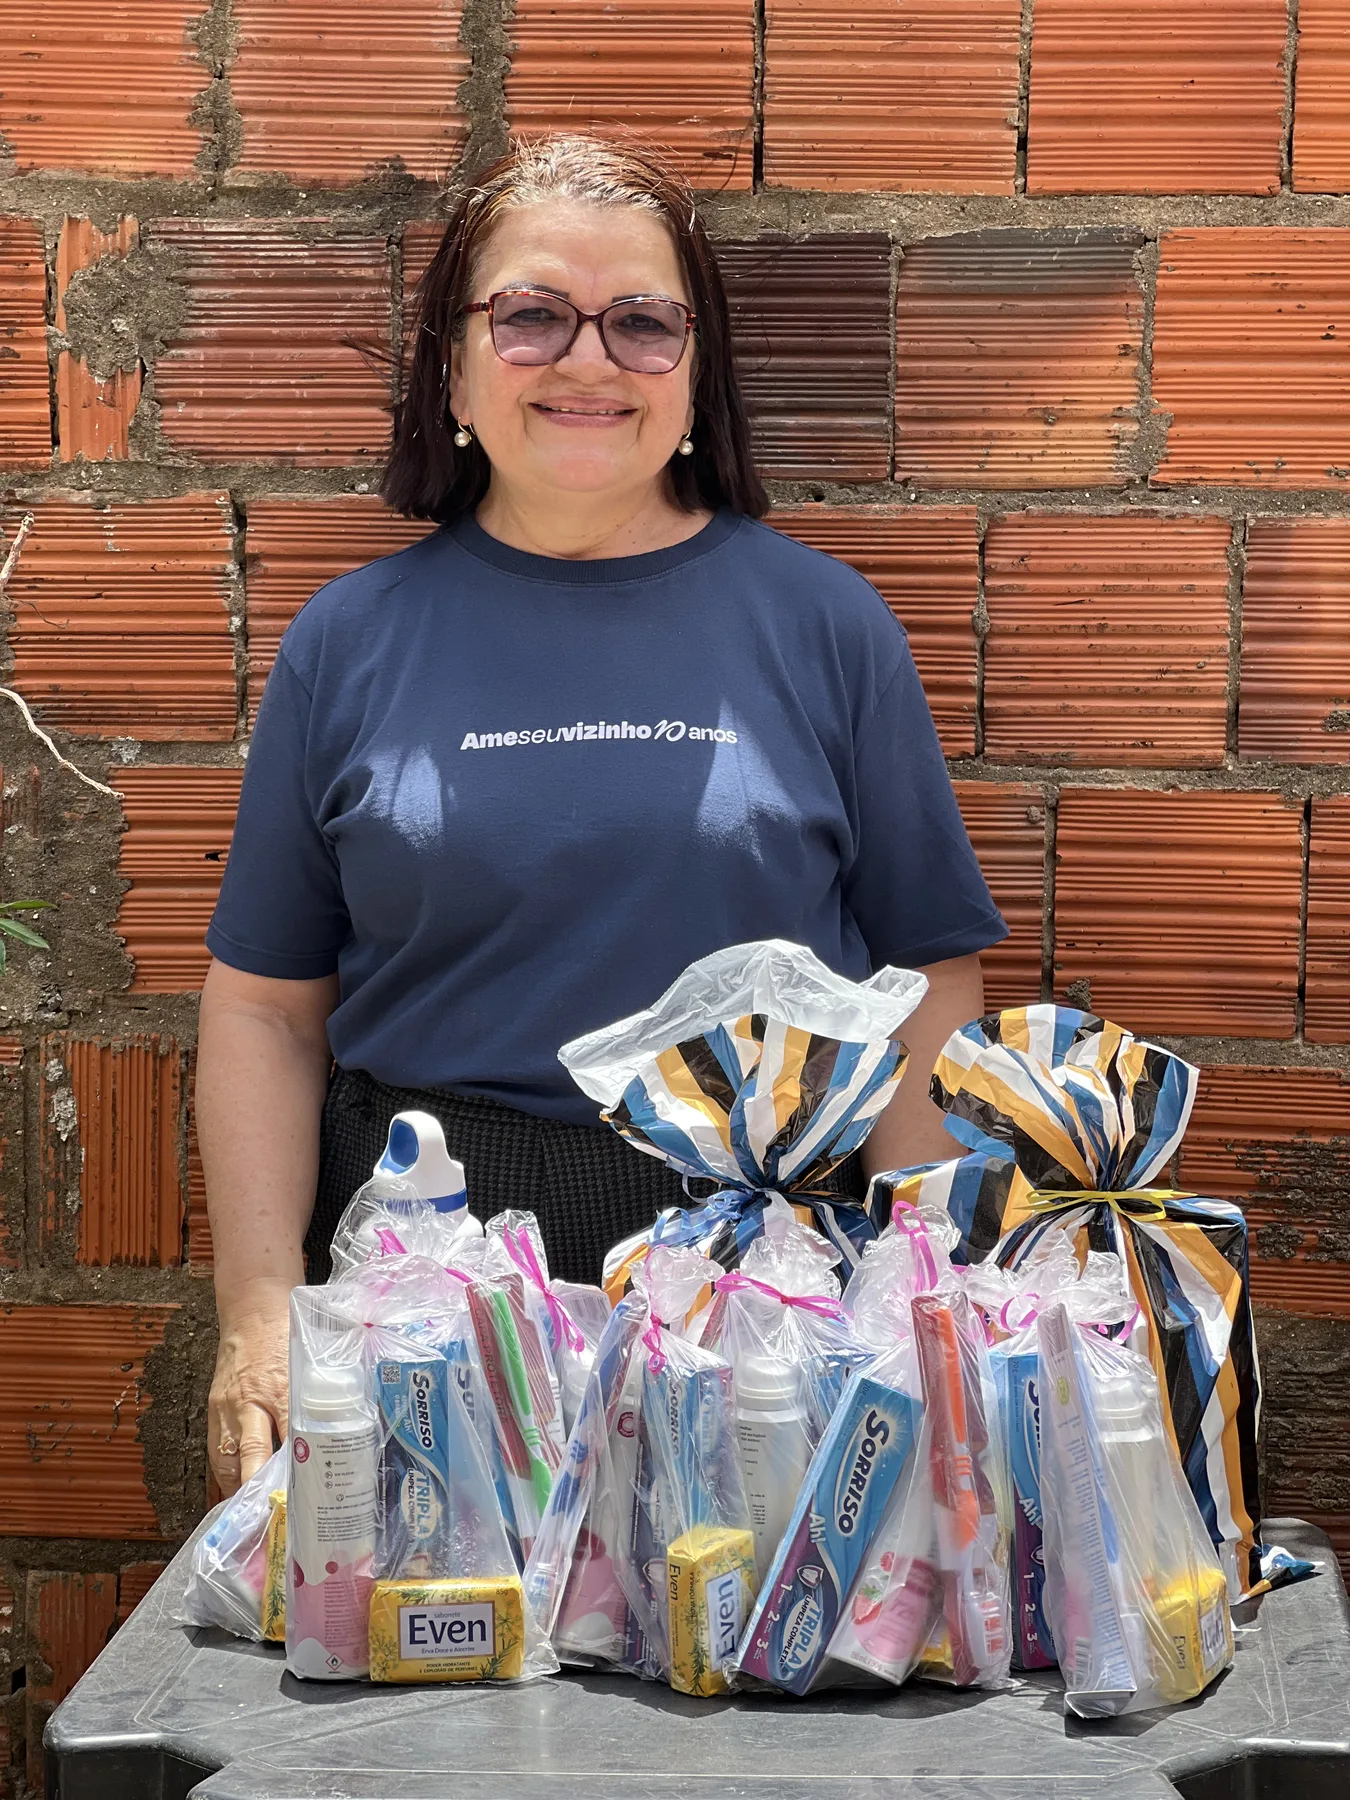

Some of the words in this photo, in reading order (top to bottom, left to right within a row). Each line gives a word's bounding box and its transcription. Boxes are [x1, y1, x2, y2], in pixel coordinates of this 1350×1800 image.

[688, 726, 738, 744] anos
[416, 1475, 430, 1534] TRIPLA
[1019, 1497, 1042, 1526] Ah!
[809, 1512, 826, 1544] Ah!
[669, 1563, 681, 1601] Even
[780, 1583, 793, 1591] 1
[718, 1579, 737, 1661] Even
[767, 1610, 780, 1621] 2
[796, 1594, 812, 1627] LIMPEZA
[1024, 1603, 1036, 1612] 2
[409, 1614, 487, 1645] Even
[756, 1638, 769, 1650] 3
[788, 1606, 824, 1665] TRIPLA
[1026, 1632, 1038, 1642] 3
[779, 1625, 799, 1666] COMPLETA
